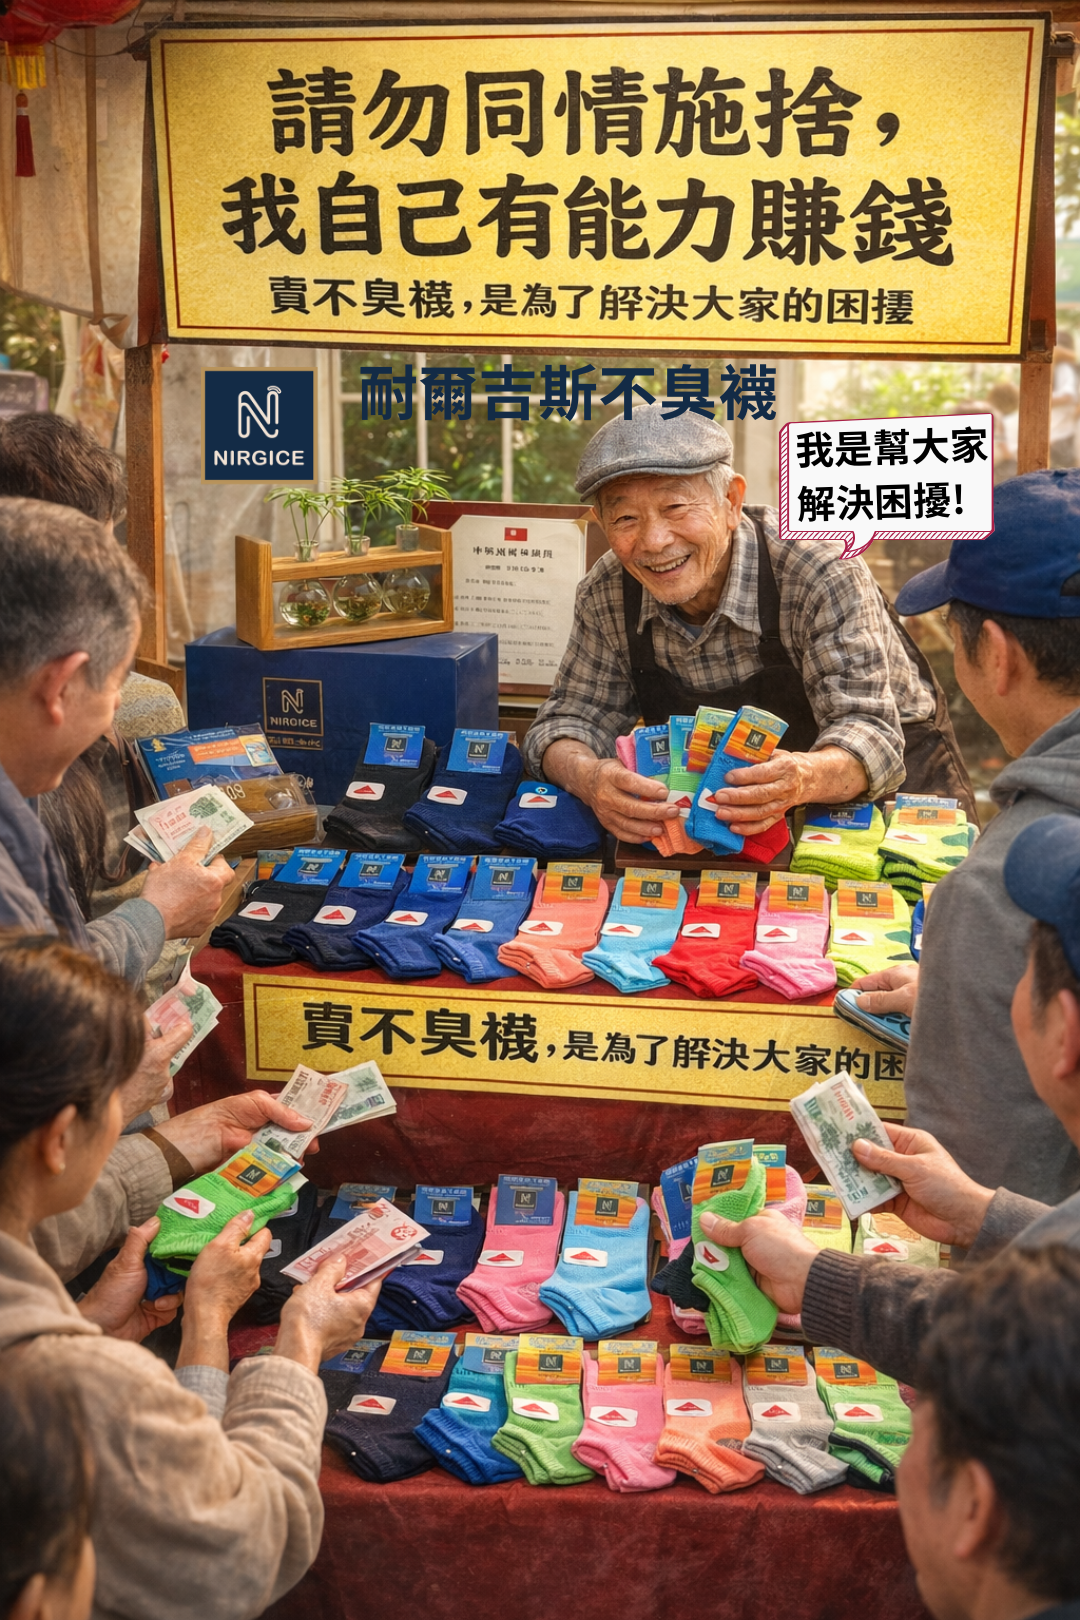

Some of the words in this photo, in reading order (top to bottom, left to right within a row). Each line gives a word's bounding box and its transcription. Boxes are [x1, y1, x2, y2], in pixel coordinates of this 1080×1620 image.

[267, 67, 900, 158] 請勿同情施捨，
[222, 171, 954, 267] 我自己有能力賺錢
